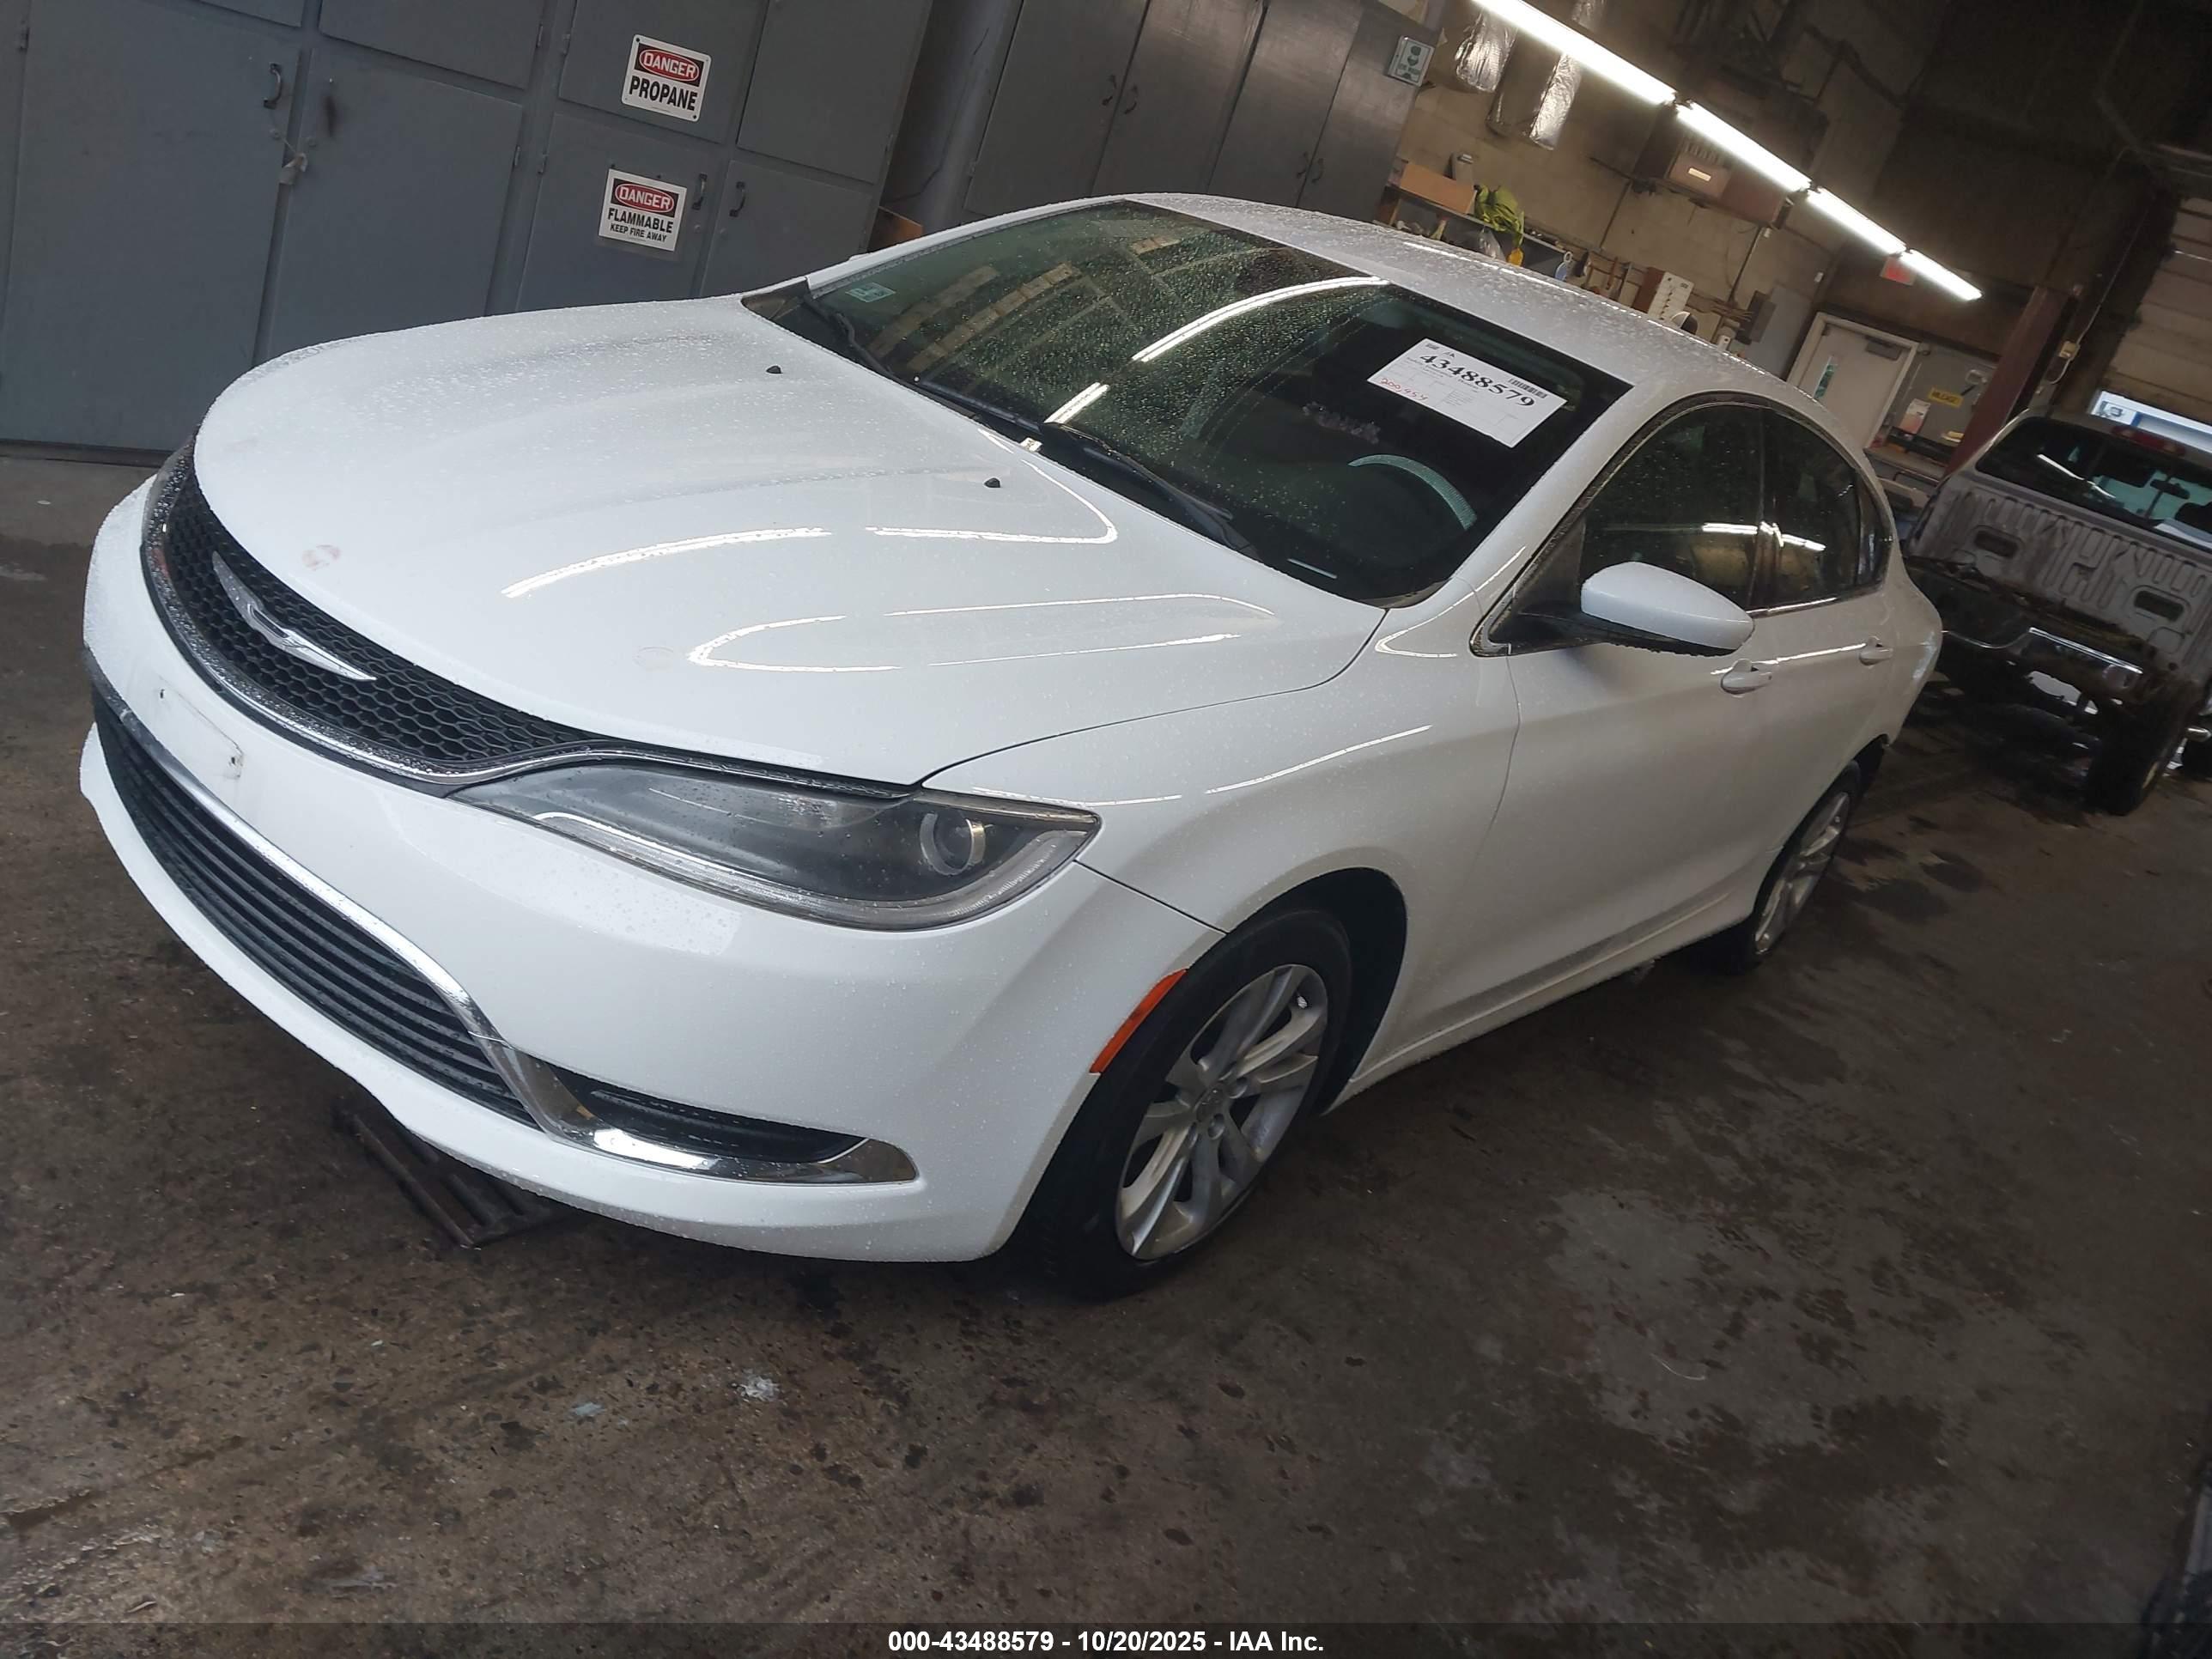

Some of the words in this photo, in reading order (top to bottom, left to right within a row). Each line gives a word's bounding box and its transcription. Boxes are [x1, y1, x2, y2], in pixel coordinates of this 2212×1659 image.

[643, 52, 697, 80] DANGER
[629, 76, 698, 111] PROPANE
[618, 186, 672, 211] DANGER
[607, 207, 674, 234] FLAMMABLE
[610, 224, 629, 234] KEEP
[629, 228, 645, 238] FIRE
[647, 231, 667, 243] AWAY
[1419, 354, 1535, 407] 43488579
